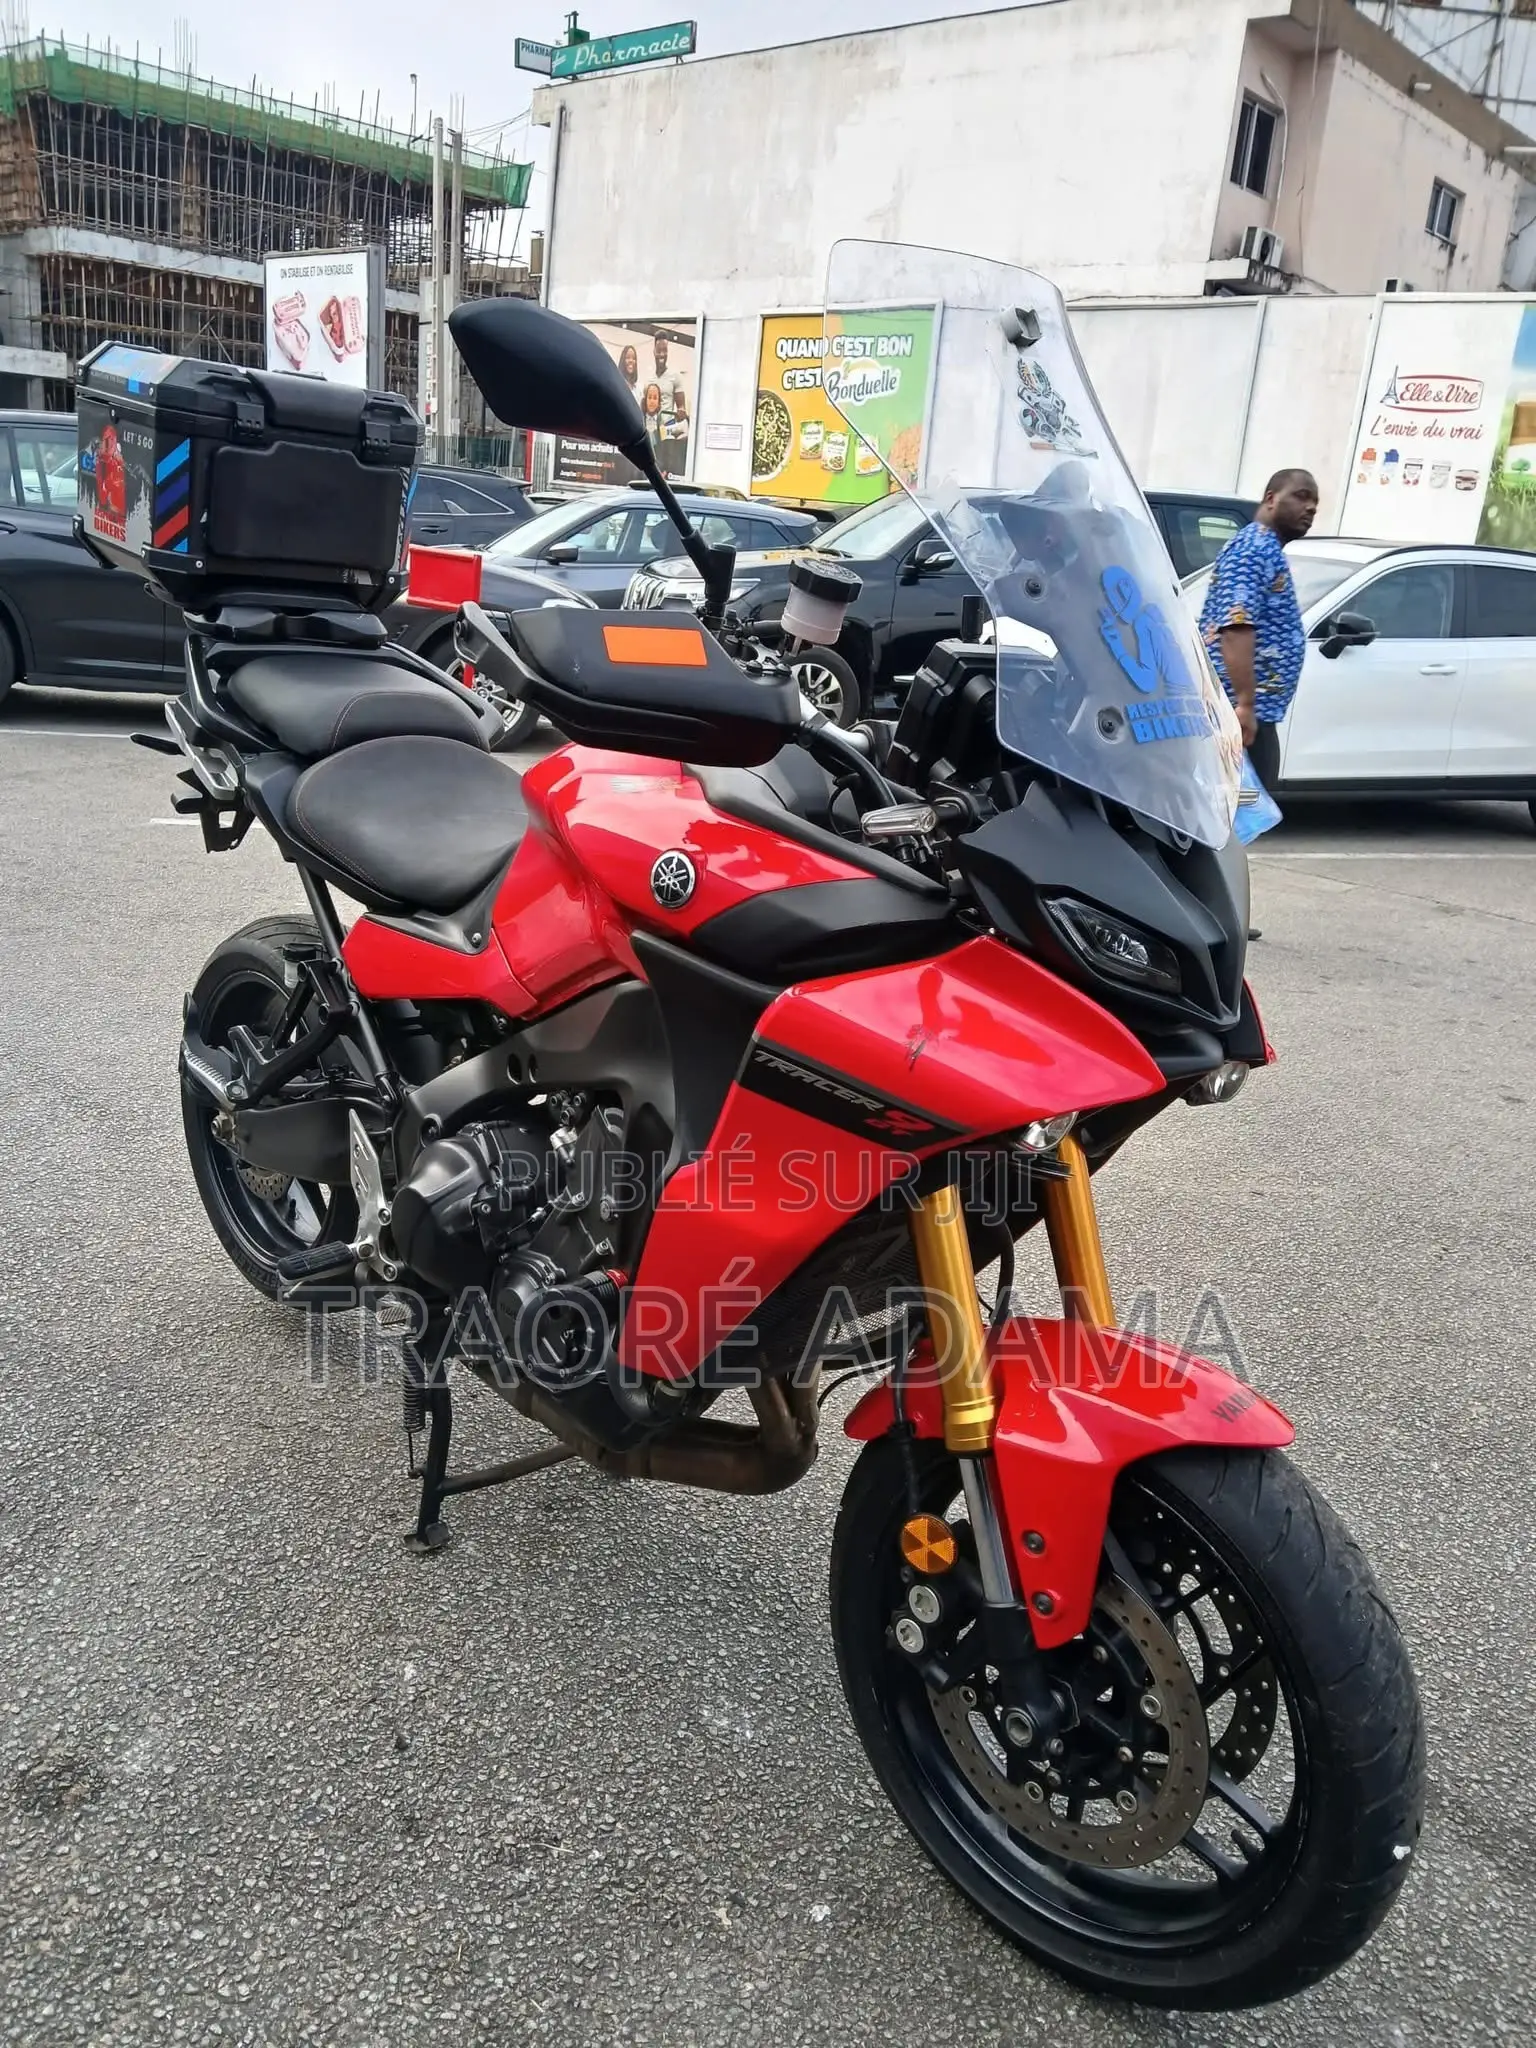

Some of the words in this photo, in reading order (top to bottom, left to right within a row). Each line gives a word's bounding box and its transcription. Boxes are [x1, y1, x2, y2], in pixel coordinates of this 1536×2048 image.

[572, 33, 691, 70] Pharmacie
[288, 267, 310, 278] STABILISE
[310, 266, 315, 277] ET
[324, 263, 353, 275] RENTABILISE
[776, 336, 831, 363] QUAND
[832, 335, 875, 358] C'EST
[876, 333, 914, 358] BON
[782, 366, 822, 391] C'EST
[827, 368, 898, 402] Bonduelle
[1370, 415, 1419, 437] L'envie
[1423, 419, 1445, 438] du
[1450, 424, 1484, 441] vrai
[142, 436, 154, 450] GO
[561, 440, 577, 450] Pour
[753, 1050, 885, 1112] TRACER
